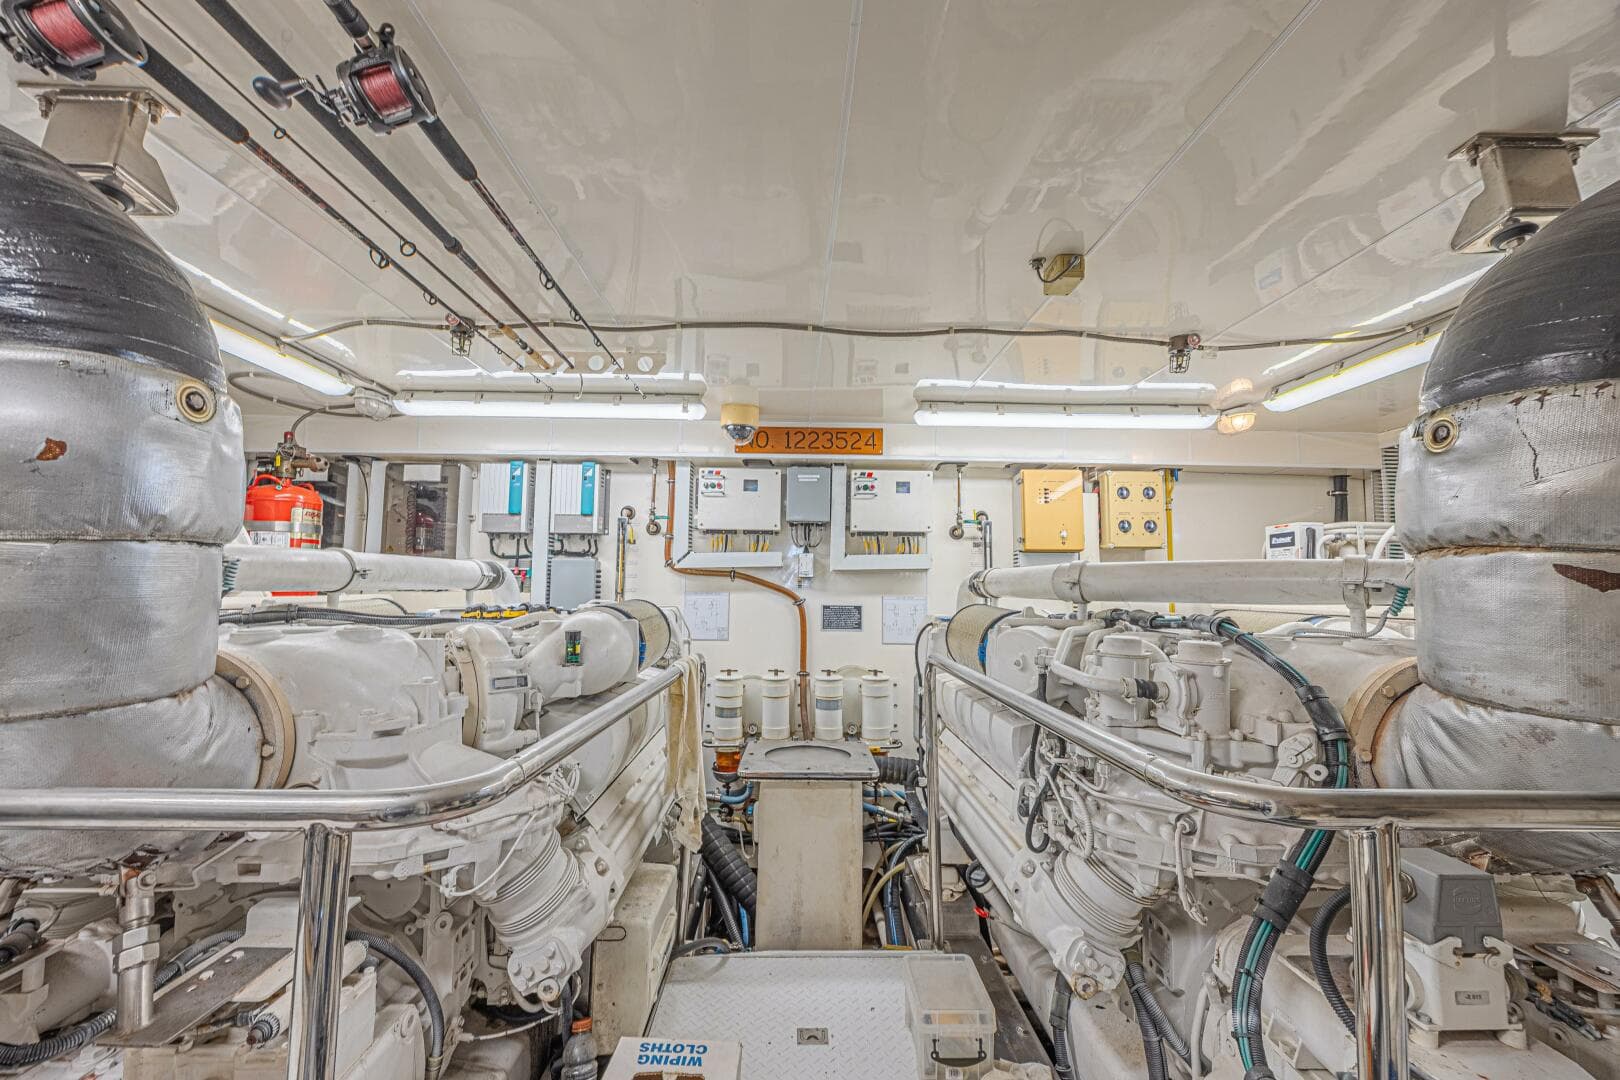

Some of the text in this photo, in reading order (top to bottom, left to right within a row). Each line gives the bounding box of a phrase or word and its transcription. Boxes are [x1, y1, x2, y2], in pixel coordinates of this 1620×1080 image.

[784, 431, 877, 451] 1223524
[639, 1042, 708, 1055] CLOTHS
[637, 1054, 703, 1067] WIPING
